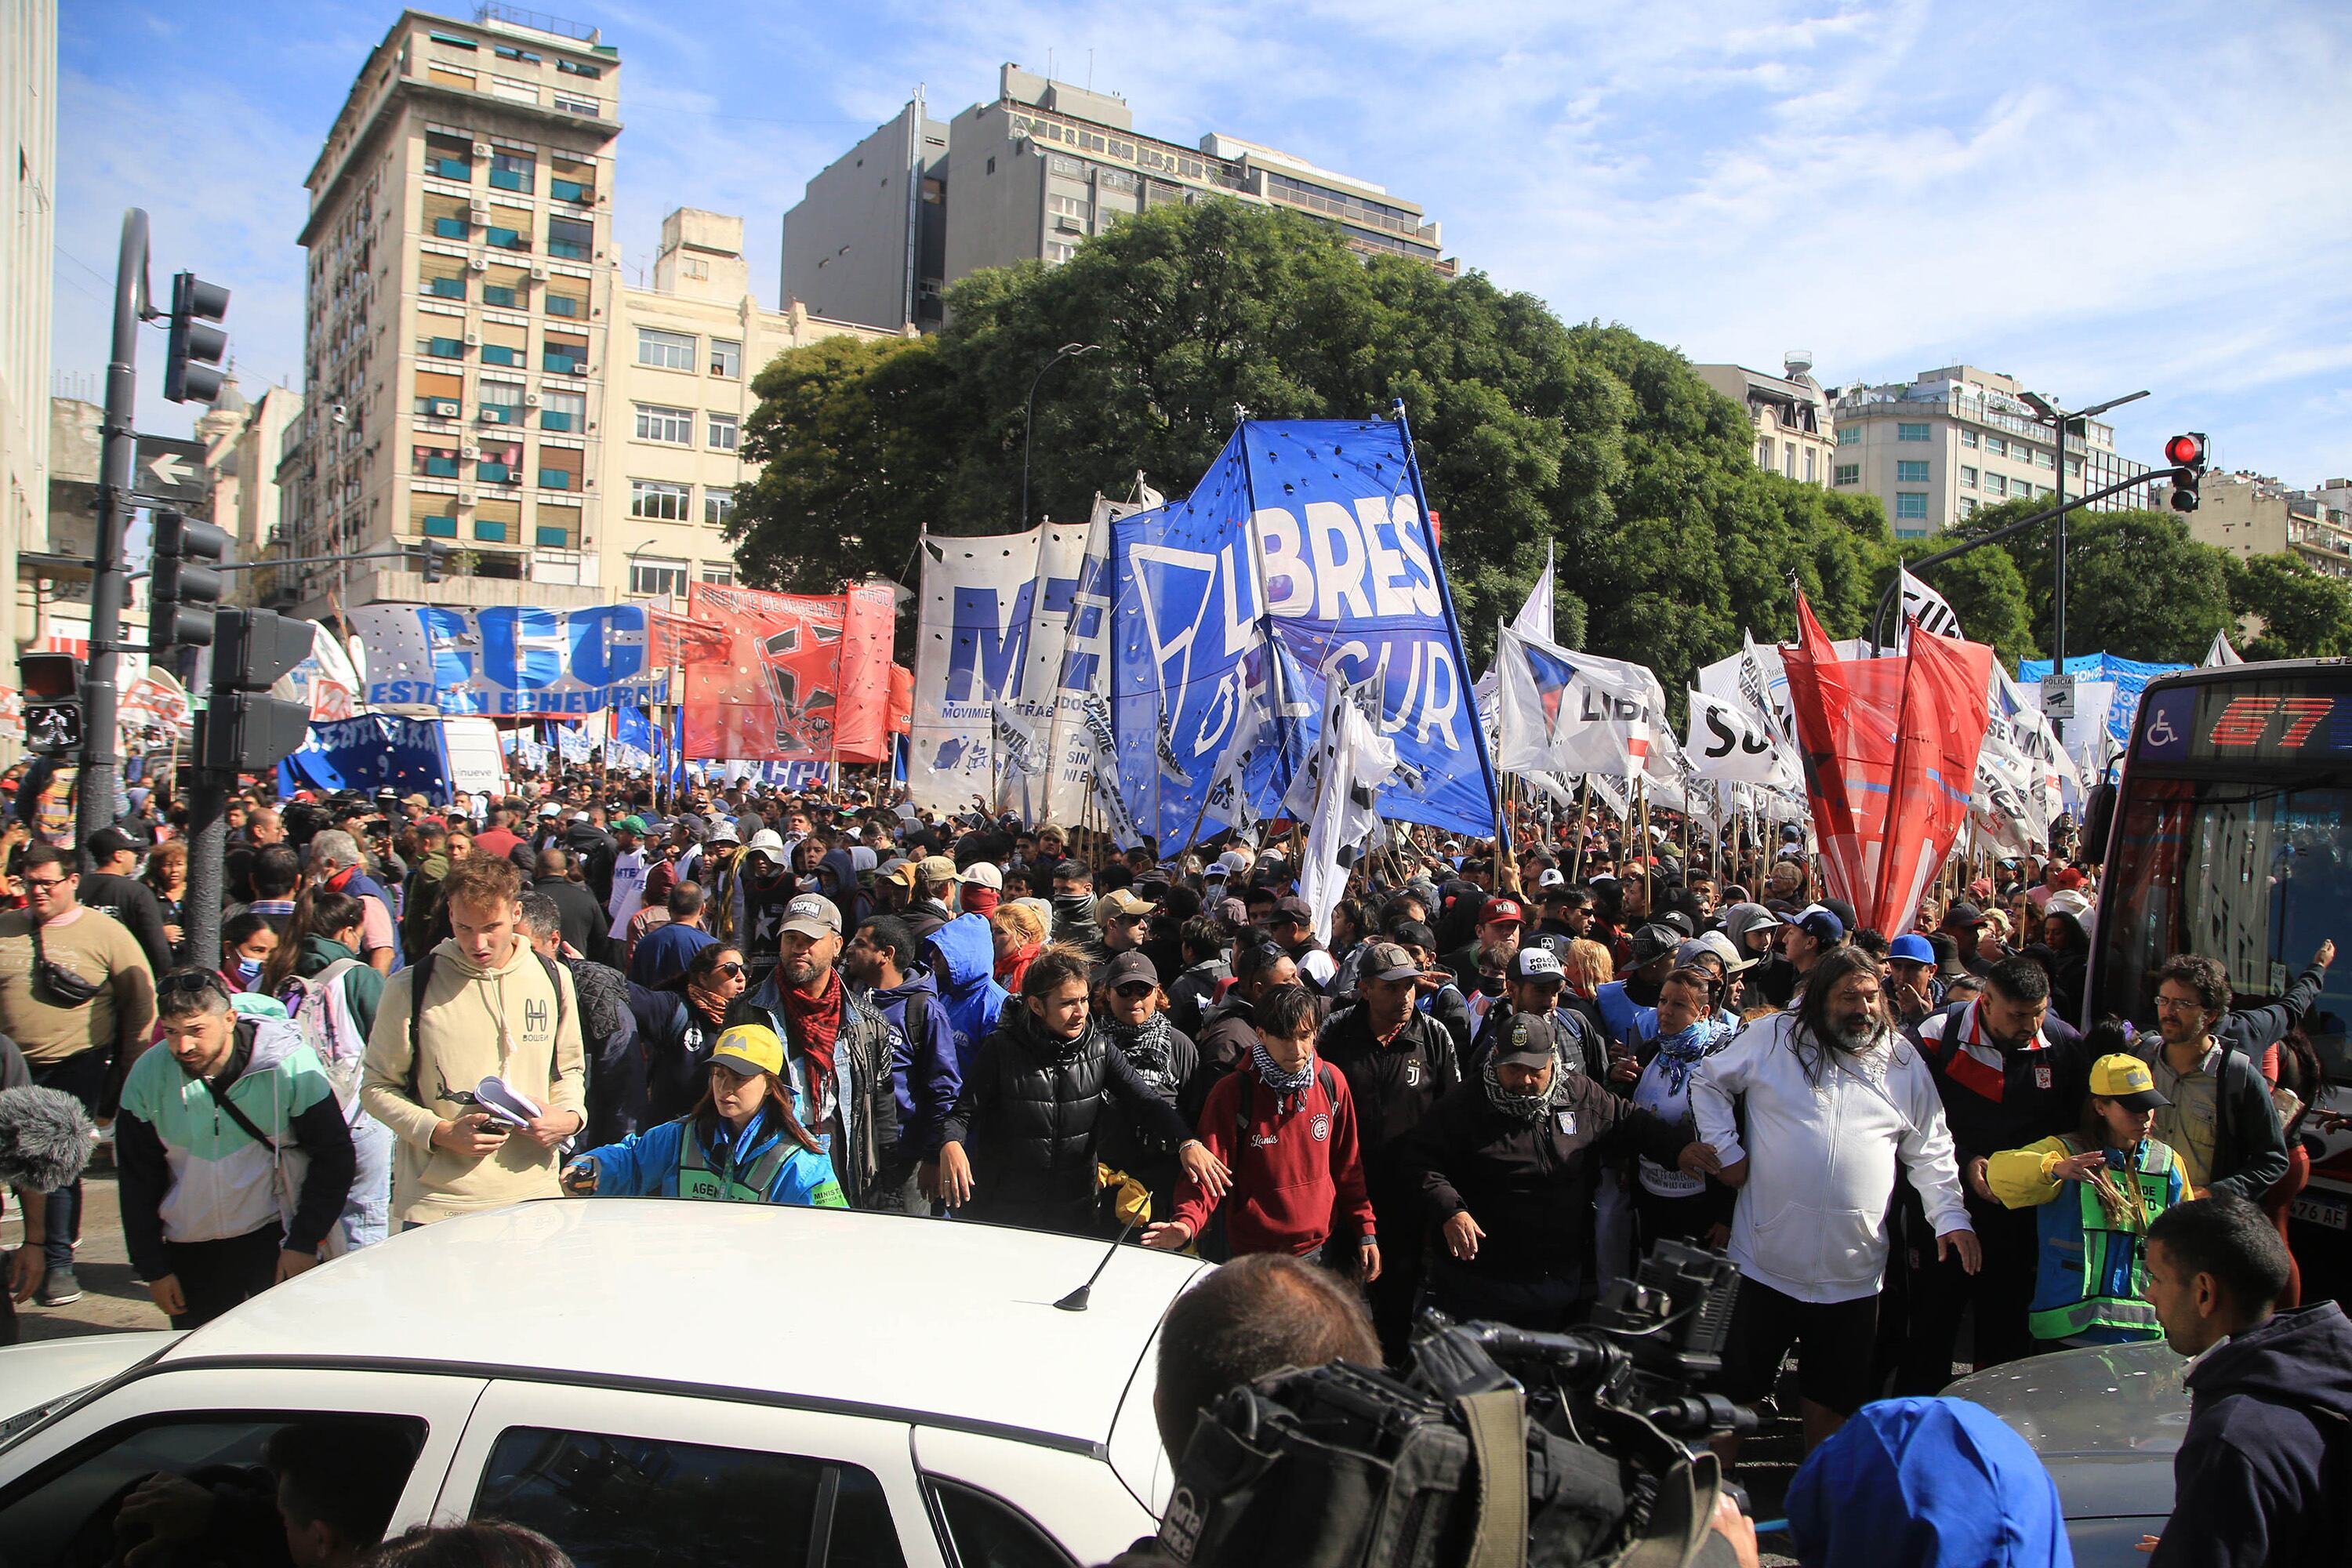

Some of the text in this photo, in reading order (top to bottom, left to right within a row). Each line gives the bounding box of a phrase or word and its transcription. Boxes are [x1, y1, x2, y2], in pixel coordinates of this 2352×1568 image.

[1221, 495, 1443, 657] LIBRES
[2209, 696, 2336, 747] 67
[1251, 1134, 1279, 1149] Lanús
